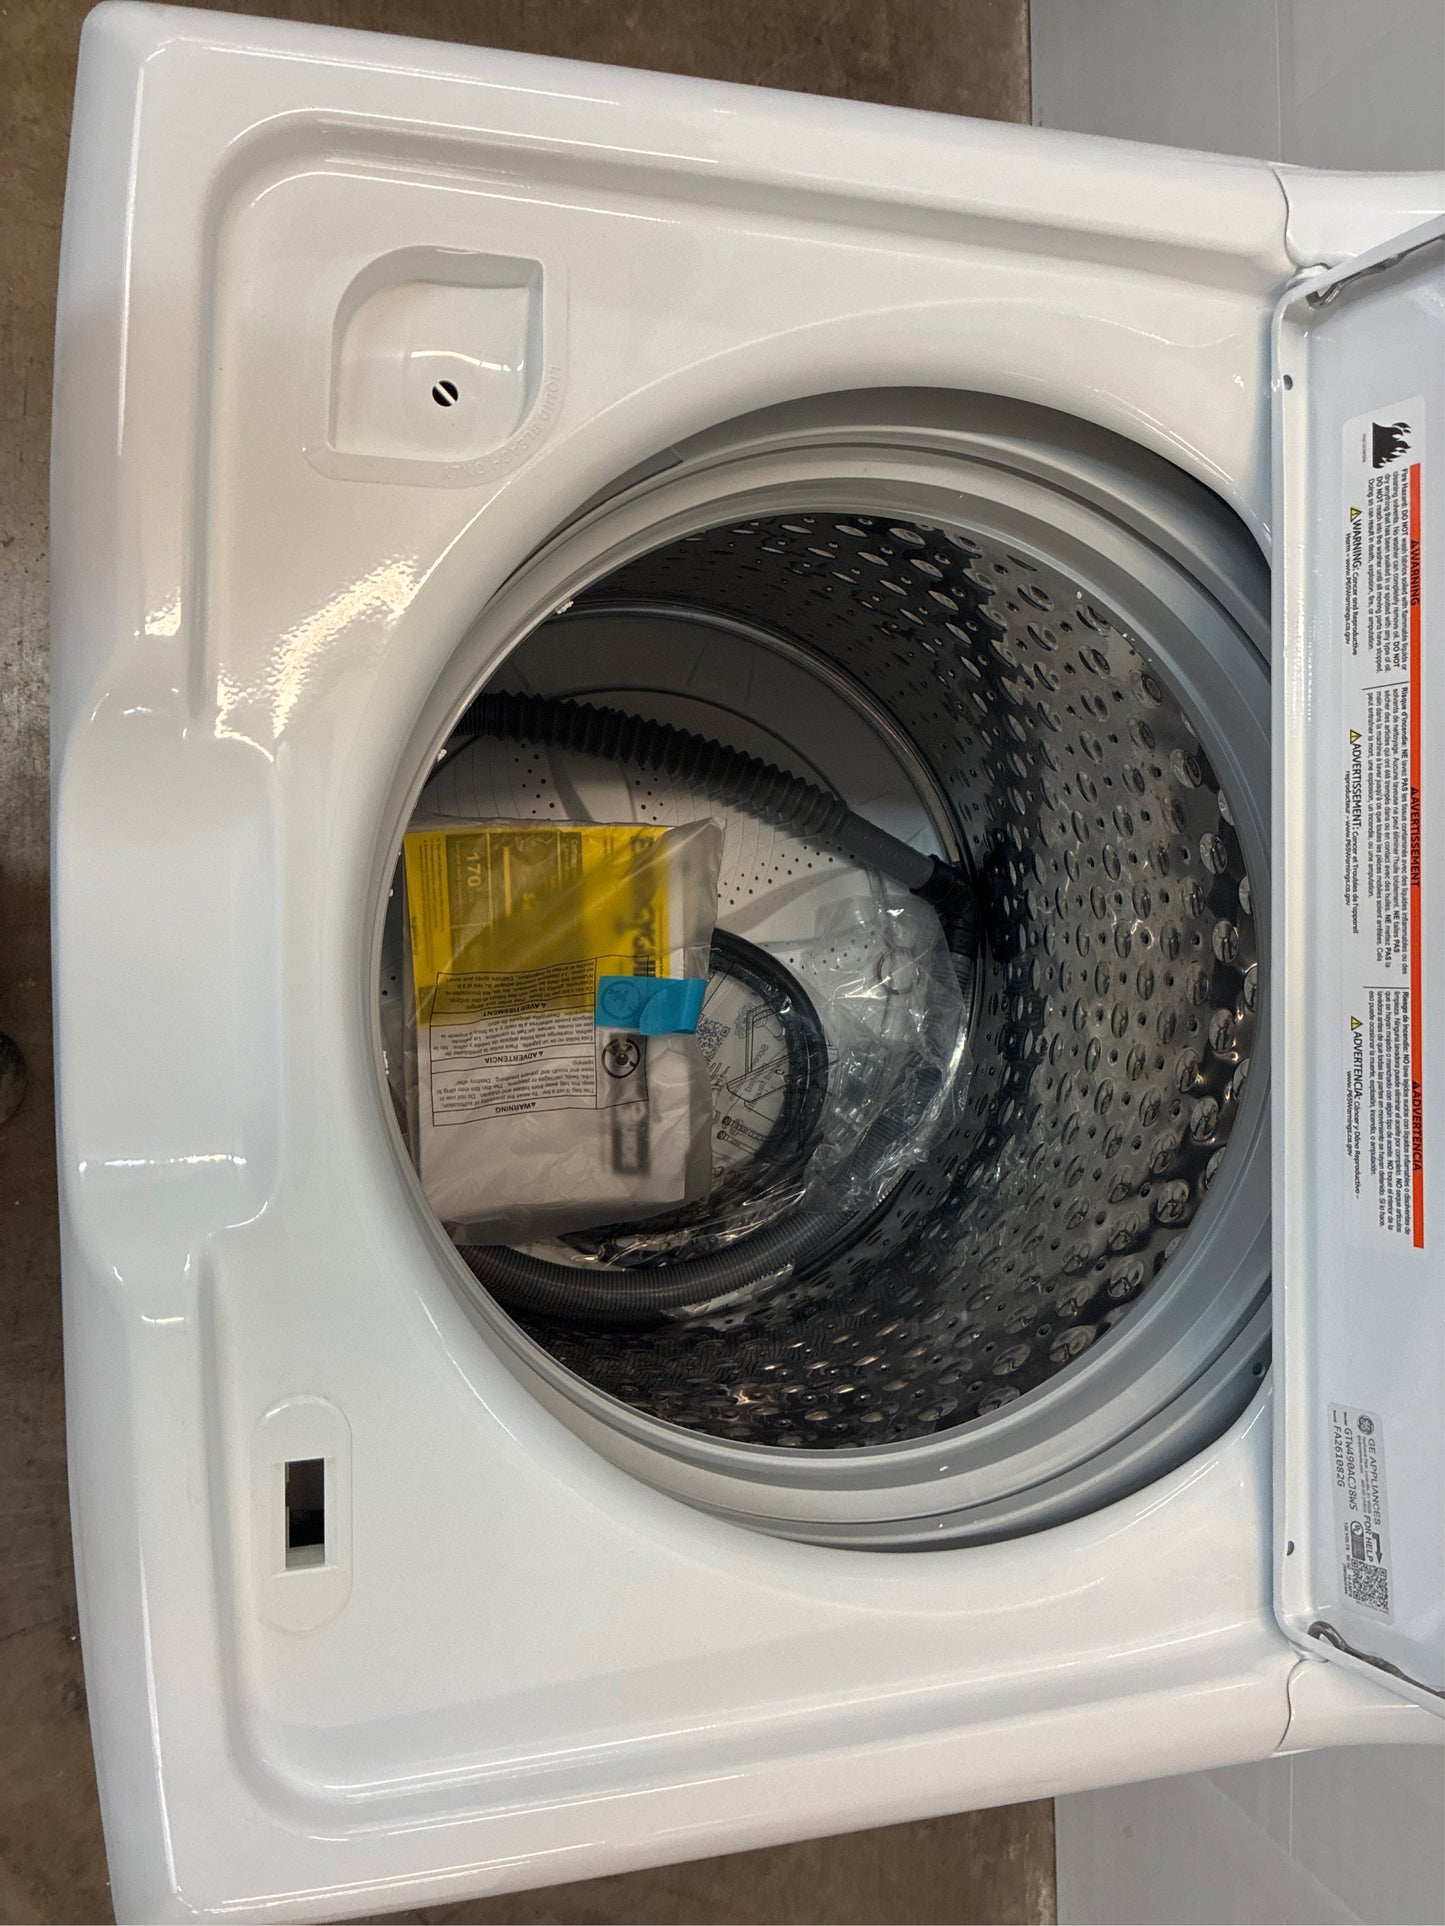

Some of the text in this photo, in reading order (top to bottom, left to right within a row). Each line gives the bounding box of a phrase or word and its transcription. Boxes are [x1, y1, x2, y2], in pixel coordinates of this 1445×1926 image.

[1353, 519, 1361, 570] WARNING:
[1411, 549, 1420, 606] WARNING
[1353, 743, 1361, 830] ADVERTISSEMENT:
[467, 852, 481, 887] 170
[1411, 797, 1420, 888] AVERTISSEMENT
[1353, 894, 1360, 902] de
[485, 1051, 537, 1064] ADVERTENCIA
[1354, 1031, 1362, 1099] ADVERTENCIA:
[495, 1103, 531, 1113] WARNING
[1412, 1091, 1422, 1171] ADVERTENCIA
[1368, 1438, 1381, 1525] GE APPLIANCES
[1364, 1515, 1372, 1533] FOR
